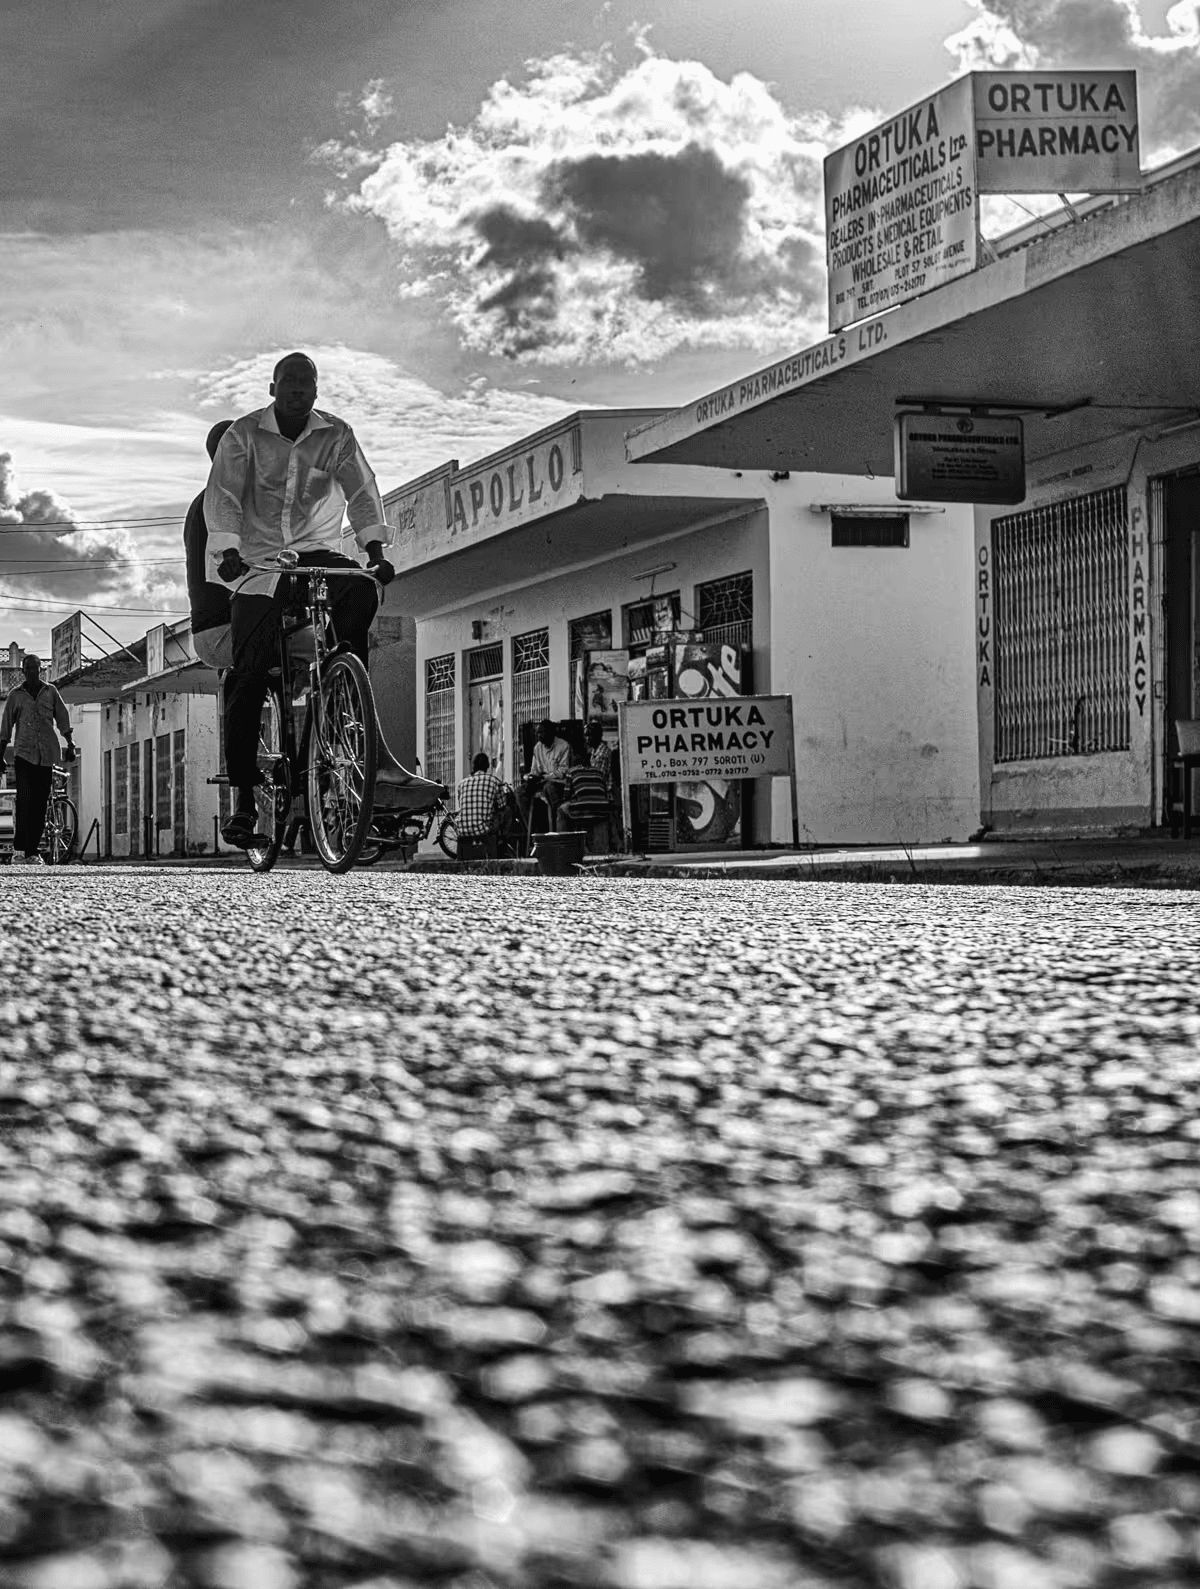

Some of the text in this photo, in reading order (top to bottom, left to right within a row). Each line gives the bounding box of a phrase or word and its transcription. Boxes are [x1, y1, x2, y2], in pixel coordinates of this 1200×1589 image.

[988, 83, 1126, 113] ORTUKA
[854, 102, 940, 178] ORTUKA
[976, 124, 1139, 159] PHARMACY
[832, 140, 946, 223] PHARMACEUTICALS
[830, 216, 865, 251] DEALERS
[832, 235, 875, 271] PRODUCTS
[884, 212, 918, 247] MEDICAL
[919, 185, 972, 230] EQUIPMENTS
[851, 243, 902, 284] WHOLESALE
[903, 239, 912, 259] &
[912, 224, 944, 256] RETAIL
[696, 321, 888, 424] ORTUKA PHARMACEUTICALS LTD.
[451, 443, 564, 537] APOLLO
[978, 545, 991, 687] ORTUKA
[1131, 506, 1147, 716] PHARMACY
[636, 729, 775, 755] PHARMACY
[651, 704, 767, 730] ORTUKA
[691, 756, 709, 767] 797
[713, 754, 747, 765] SOROTI
[749, 752, 766, 765] (U)
[724, 766, 750, 776] 621717
